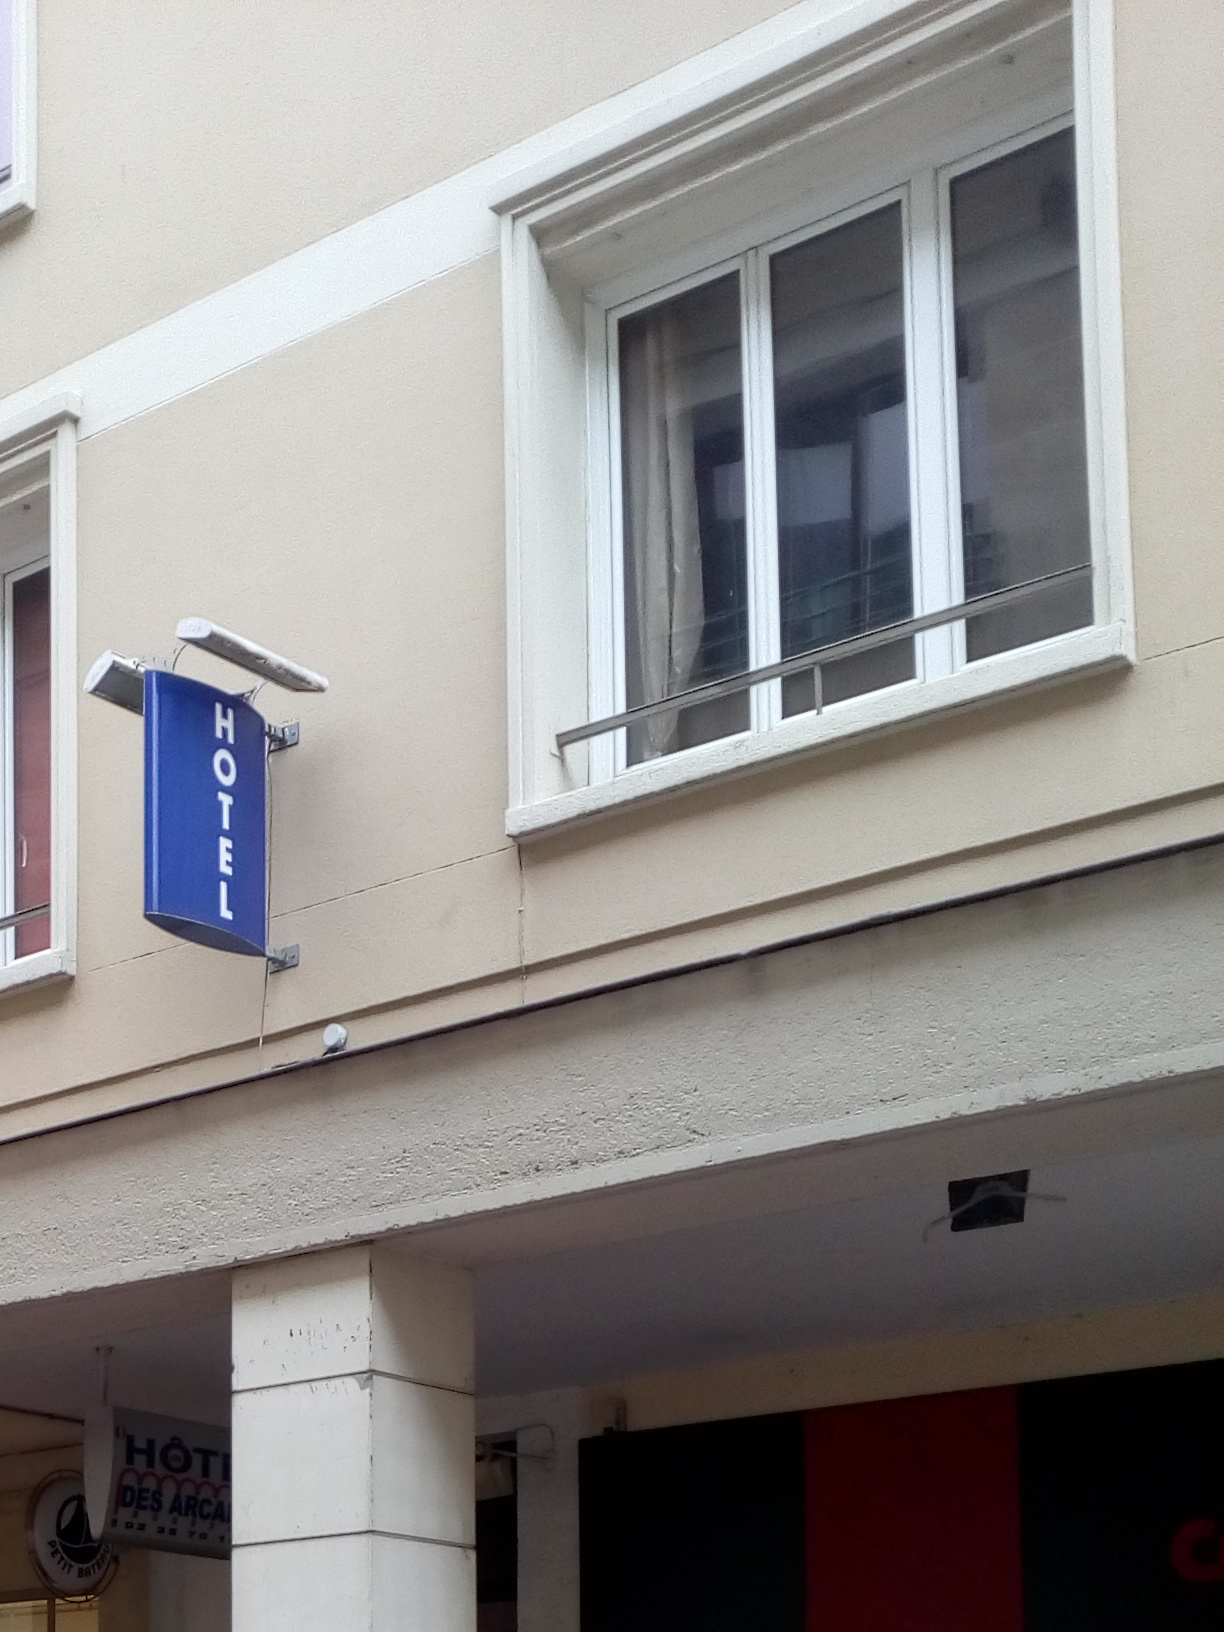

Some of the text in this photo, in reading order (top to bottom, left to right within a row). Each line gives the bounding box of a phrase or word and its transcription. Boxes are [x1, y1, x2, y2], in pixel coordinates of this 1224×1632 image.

[212, 701, 238, 921] HOTEL
[120, 1484, 164, 1513] DES
[47, 1540, 74, 1575] PETIT
